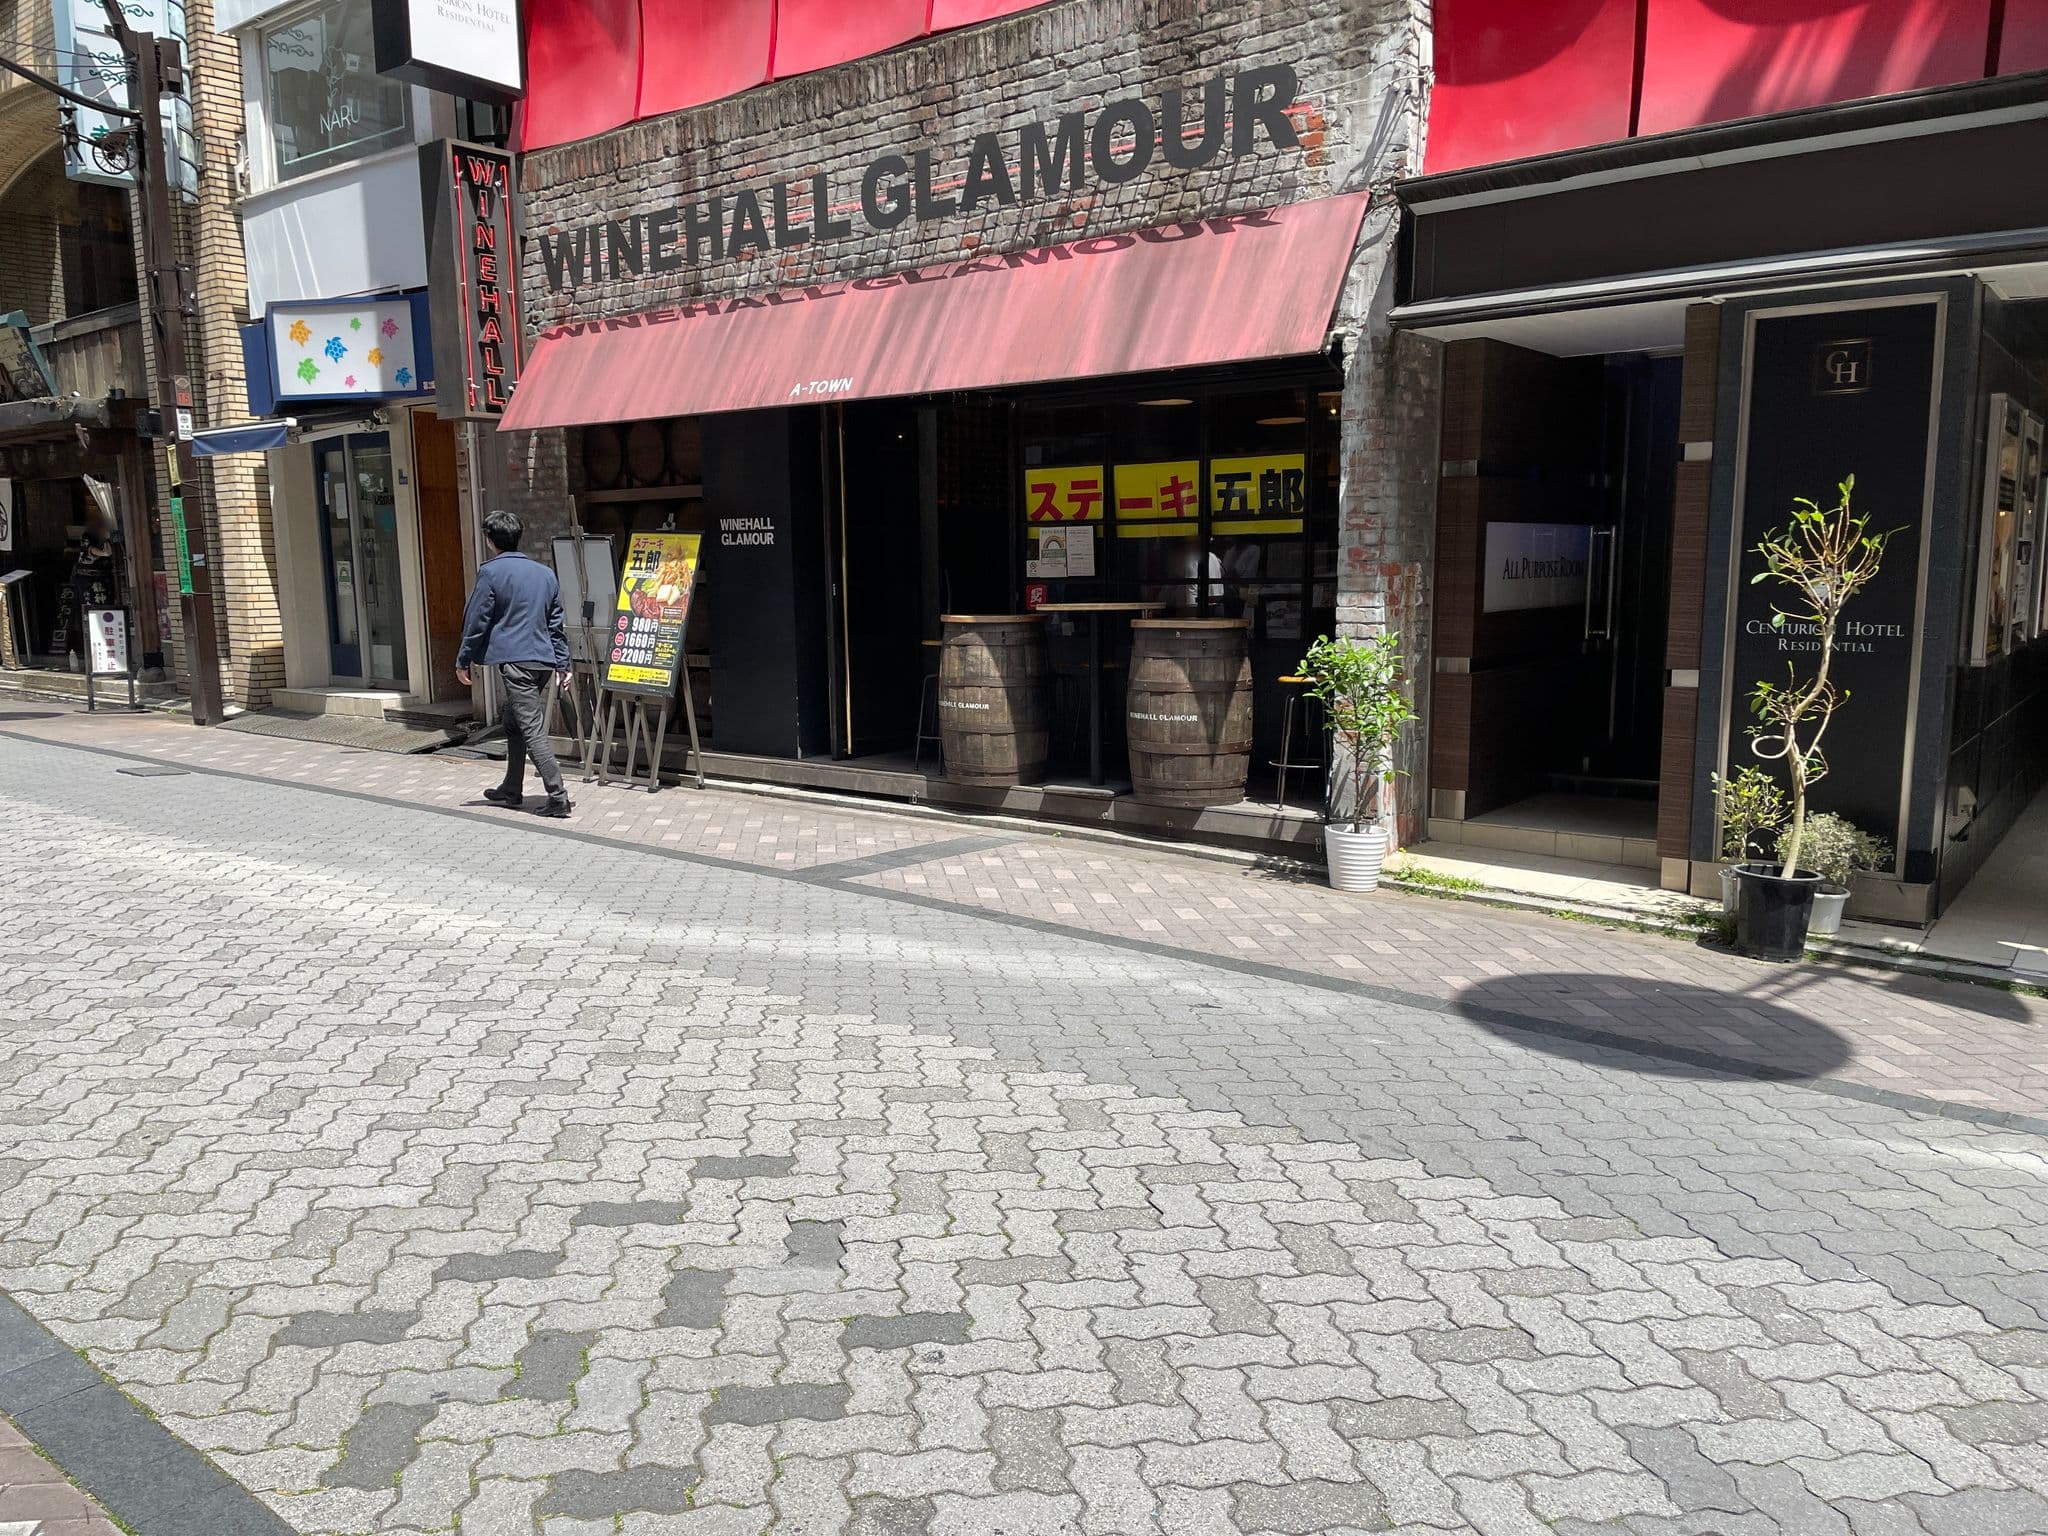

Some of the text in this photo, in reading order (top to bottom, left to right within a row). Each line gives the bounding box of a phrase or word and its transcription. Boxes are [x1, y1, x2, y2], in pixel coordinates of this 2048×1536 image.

[437, 5, 495, 33] RESIDENTIAL
[477, 3, 511, 24] HOTEL
[320, 99, 360, 134] NARU
[538, 63, 1300, 291] WINEHALL GLAMOUR
[467, 155, 508, 406] WINEHALL
[789, 377, 854, 397] A-TOWN
[720, 516, 775, 531] WINEHALL
[634, 537, 665, 549] ステーキ
[721, 532, 775, 546] GLAMOUR
[630, 550, 661, 573] 五郎
[1503, 556, 1520, 580] ALL
[1521, 557, 1559, 580] PURPOSE
[632, 616, 659, 633] 980円
[1846, 621, 1905, 637] HOTEL
[624, 632, 656, 649] 1660円
[1778, 638, 1876, 653] RESIDNTIAL
[620, 648, 653, 665] 2200円
[1159, 714, 1198, 722] GLAMOUR
